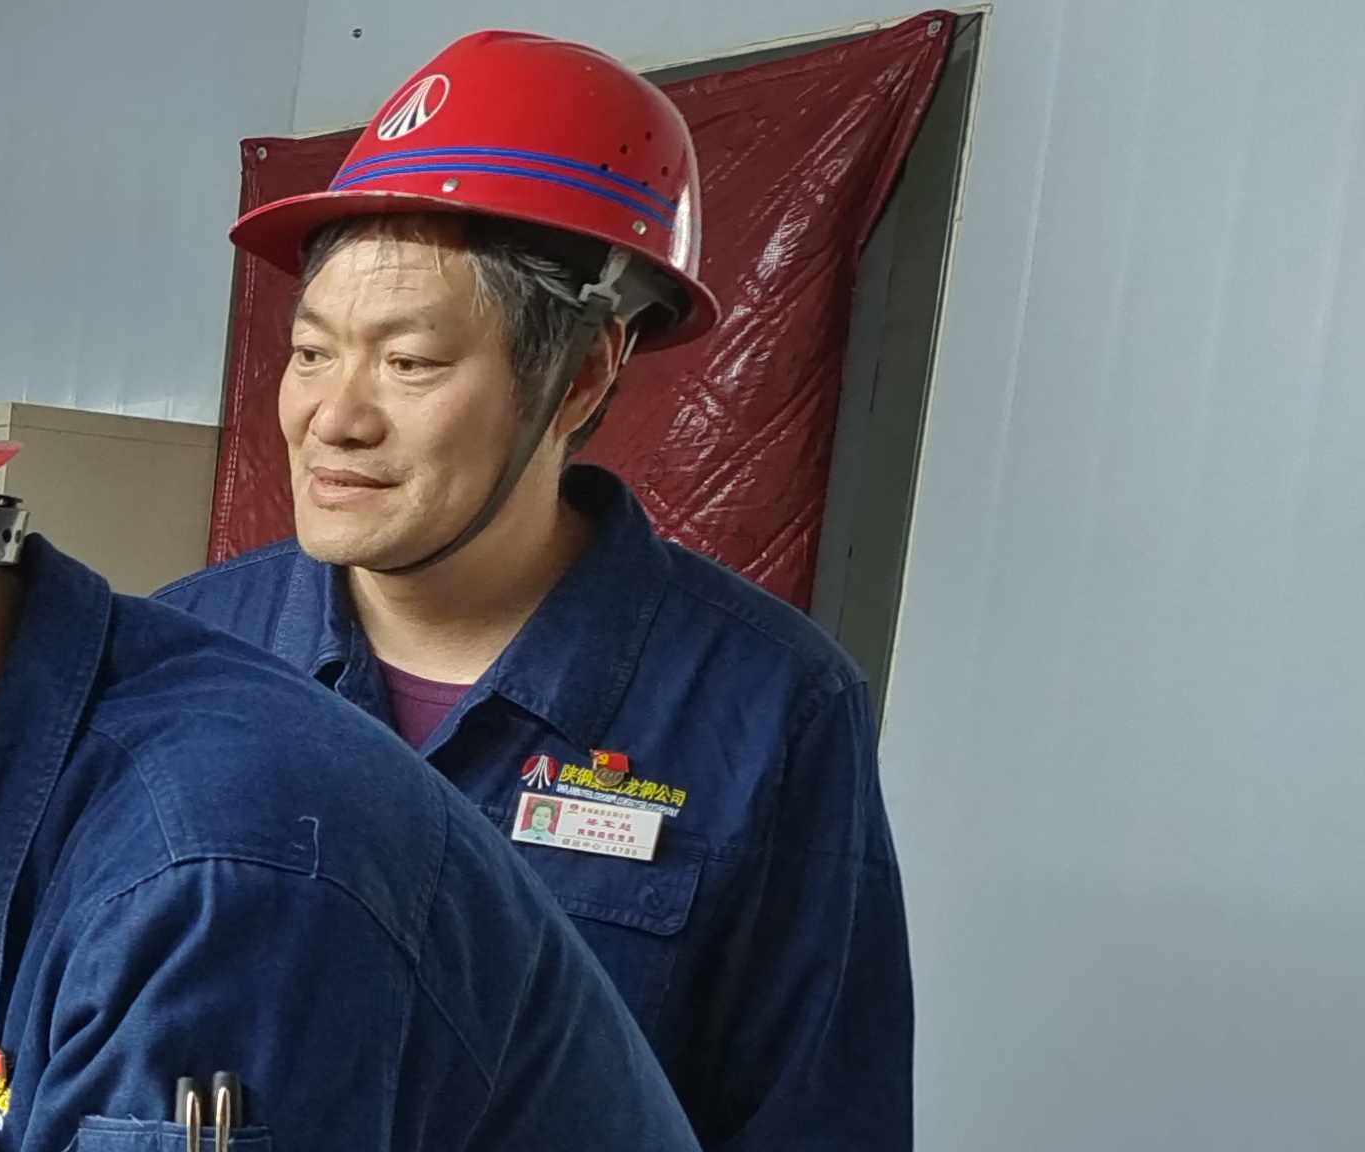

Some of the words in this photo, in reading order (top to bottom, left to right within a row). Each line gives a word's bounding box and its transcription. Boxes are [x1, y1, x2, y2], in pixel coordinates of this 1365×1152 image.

[560, 764, 687, 807] 陕钢龙钢公司
